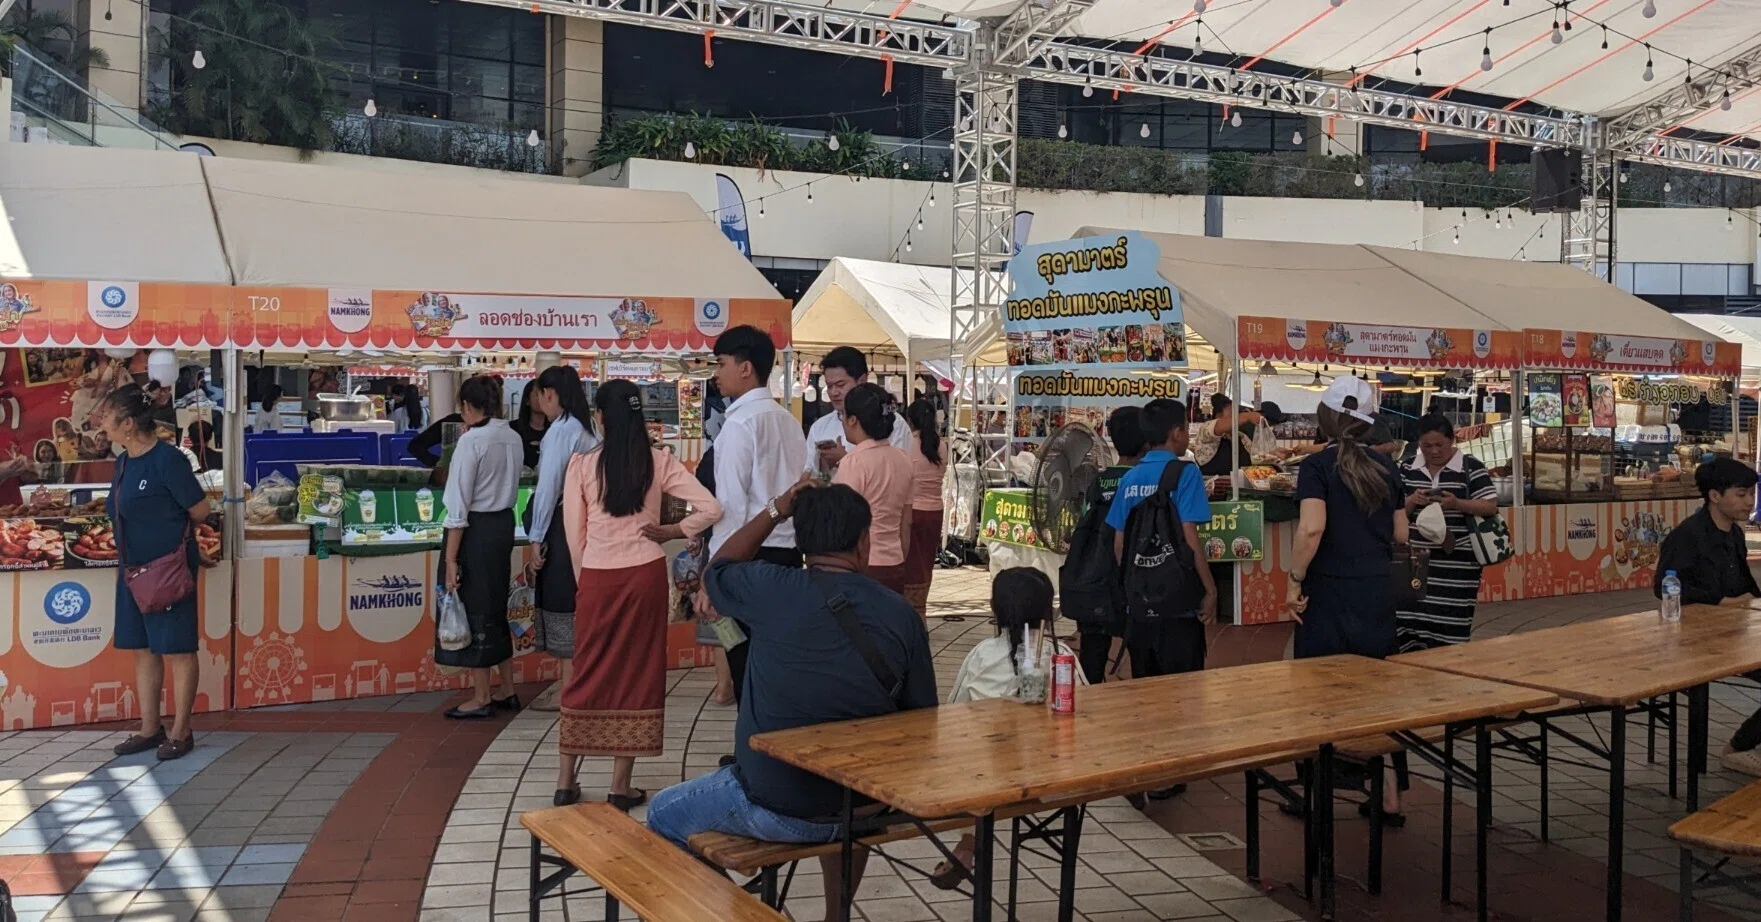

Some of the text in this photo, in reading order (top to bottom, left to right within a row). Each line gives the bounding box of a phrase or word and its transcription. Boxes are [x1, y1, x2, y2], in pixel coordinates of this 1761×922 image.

[1037, 236, 1128, 285] สุดามาตร์
[247, 295, 281, 312] T20
[330, 307, 371, 316] NAMKHONG
[1007, 287, 1173, 321] ทอดมันแมงกะพรุน
[478, 308, 598, 327] ลอดช่องบ้านเรา
[1246, 322, 1263, 335] T19
[1530, 334, 1544, 345] T18
[1567, 528, 1597, 540] NAMKHONG
[350, 592, 422, 610] NAMKHONG
